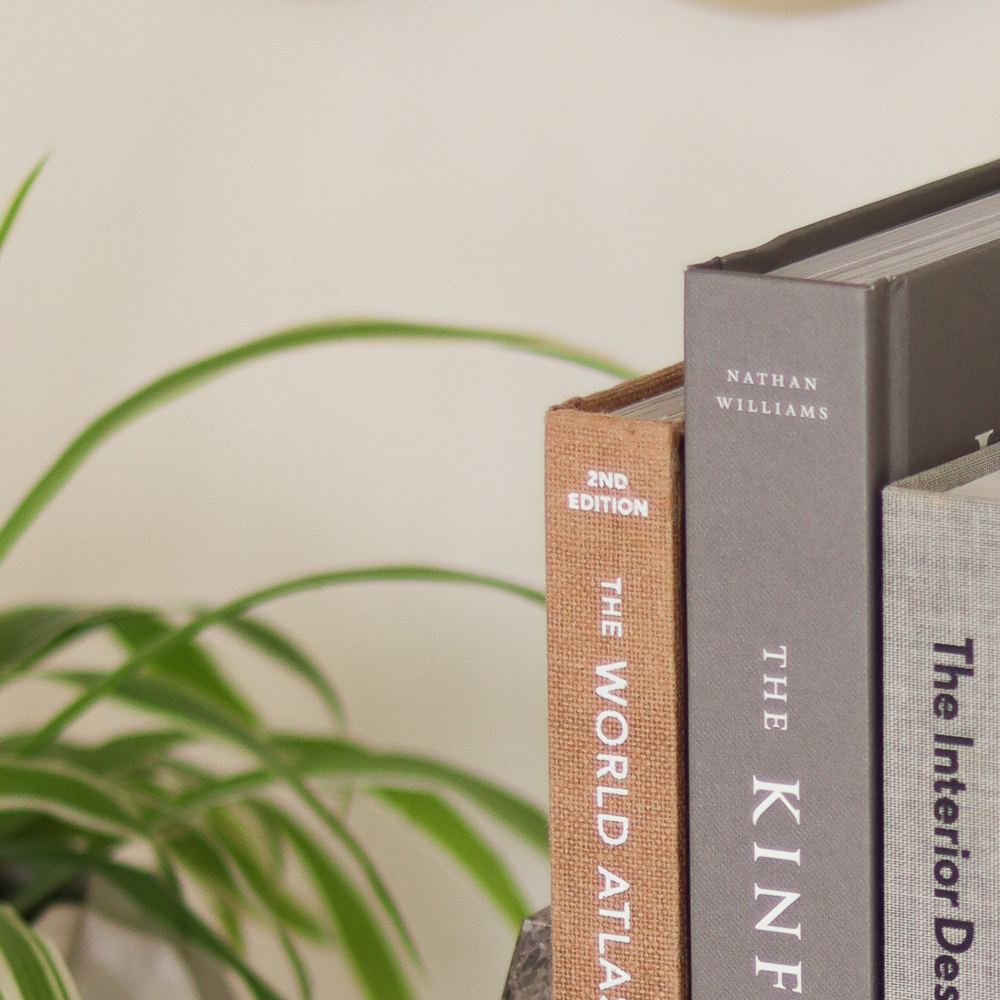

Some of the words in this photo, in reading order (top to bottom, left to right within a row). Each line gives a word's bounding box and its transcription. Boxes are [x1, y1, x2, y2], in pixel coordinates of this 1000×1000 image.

[717, 396, 829, 421] WILLIAMS
[727, 369, 818, 391] NATHAN
[568, 493, 649, 518] EDITION
[587, 470, 629, 490] 2ND
[600, 577, 622, 638] THE
[763, 645, 788, 731] THE
[933, 637, 974, 719] The
[595, 661, 629, 846] WORLD
[933, 733, 975, 908] Interior
